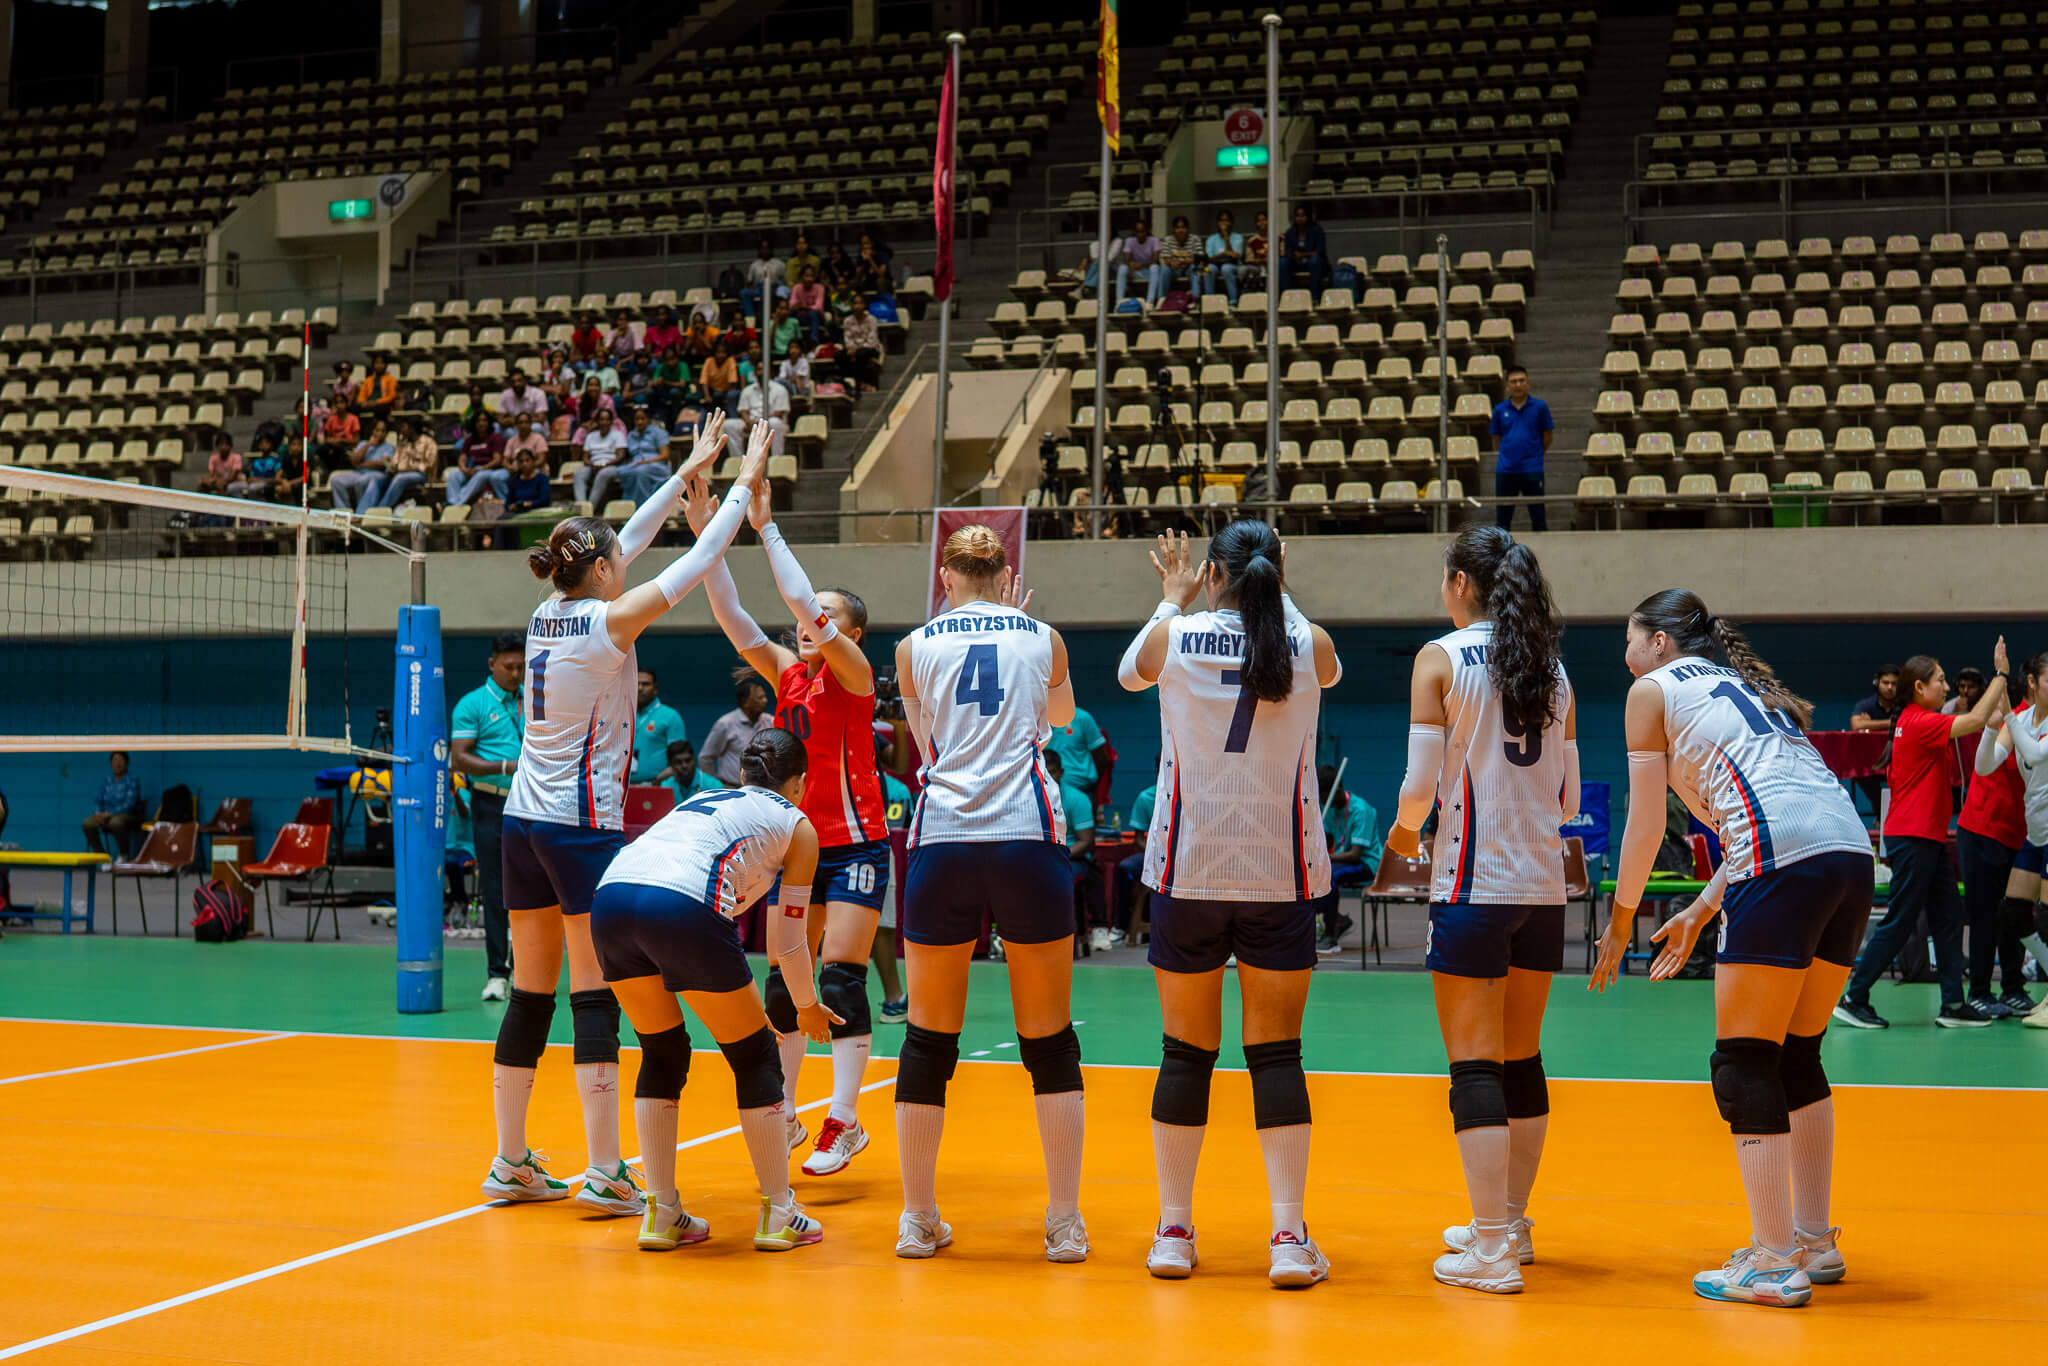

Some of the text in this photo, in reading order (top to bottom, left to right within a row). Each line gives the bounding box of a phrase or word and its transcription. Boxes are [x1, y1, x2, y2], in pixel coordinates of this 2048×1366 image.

[1231, 131, 1257, 142] EXIT
[1238, 115, 1249, 129] 6
[924, 615, 1038, 639] KYRGYZSTAN
[1181, 632, 1299, 657] KYRGYN
[529, 650, 551, 721] 1
[956, 644, 1004, 716] 4
[1669, 663, 1742, 682] KYRGYZ
[779, 704, 811, 740] 10
[1220, 669, 1259, 753] 7
[1501, 690, 1542, 767] 9
[675, 789, 746, 816] 2
[845, 863, 875, 894] 10
